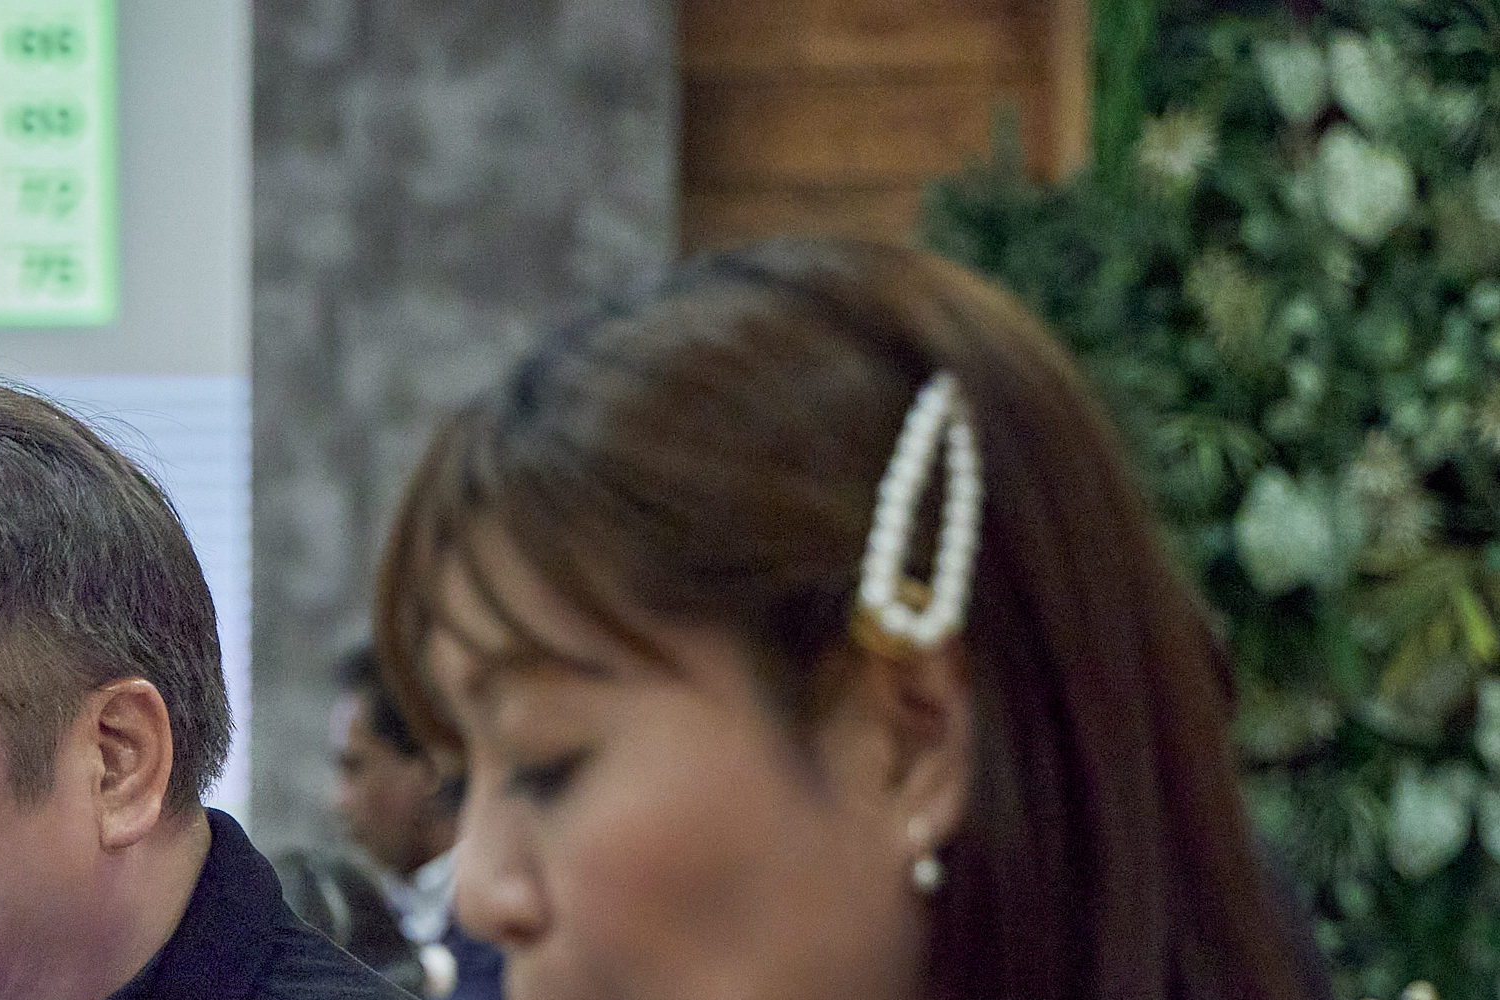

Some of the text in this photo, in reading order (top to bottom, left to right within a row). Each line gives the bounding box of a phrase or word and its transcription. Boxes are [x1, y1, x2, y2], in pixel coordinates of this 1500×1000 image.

[8, 18, 84, 66] 66
[9, 97, 83, 145] 69
[11, 172, 84, 223] 72
[13, 248, 85, 296] 75
